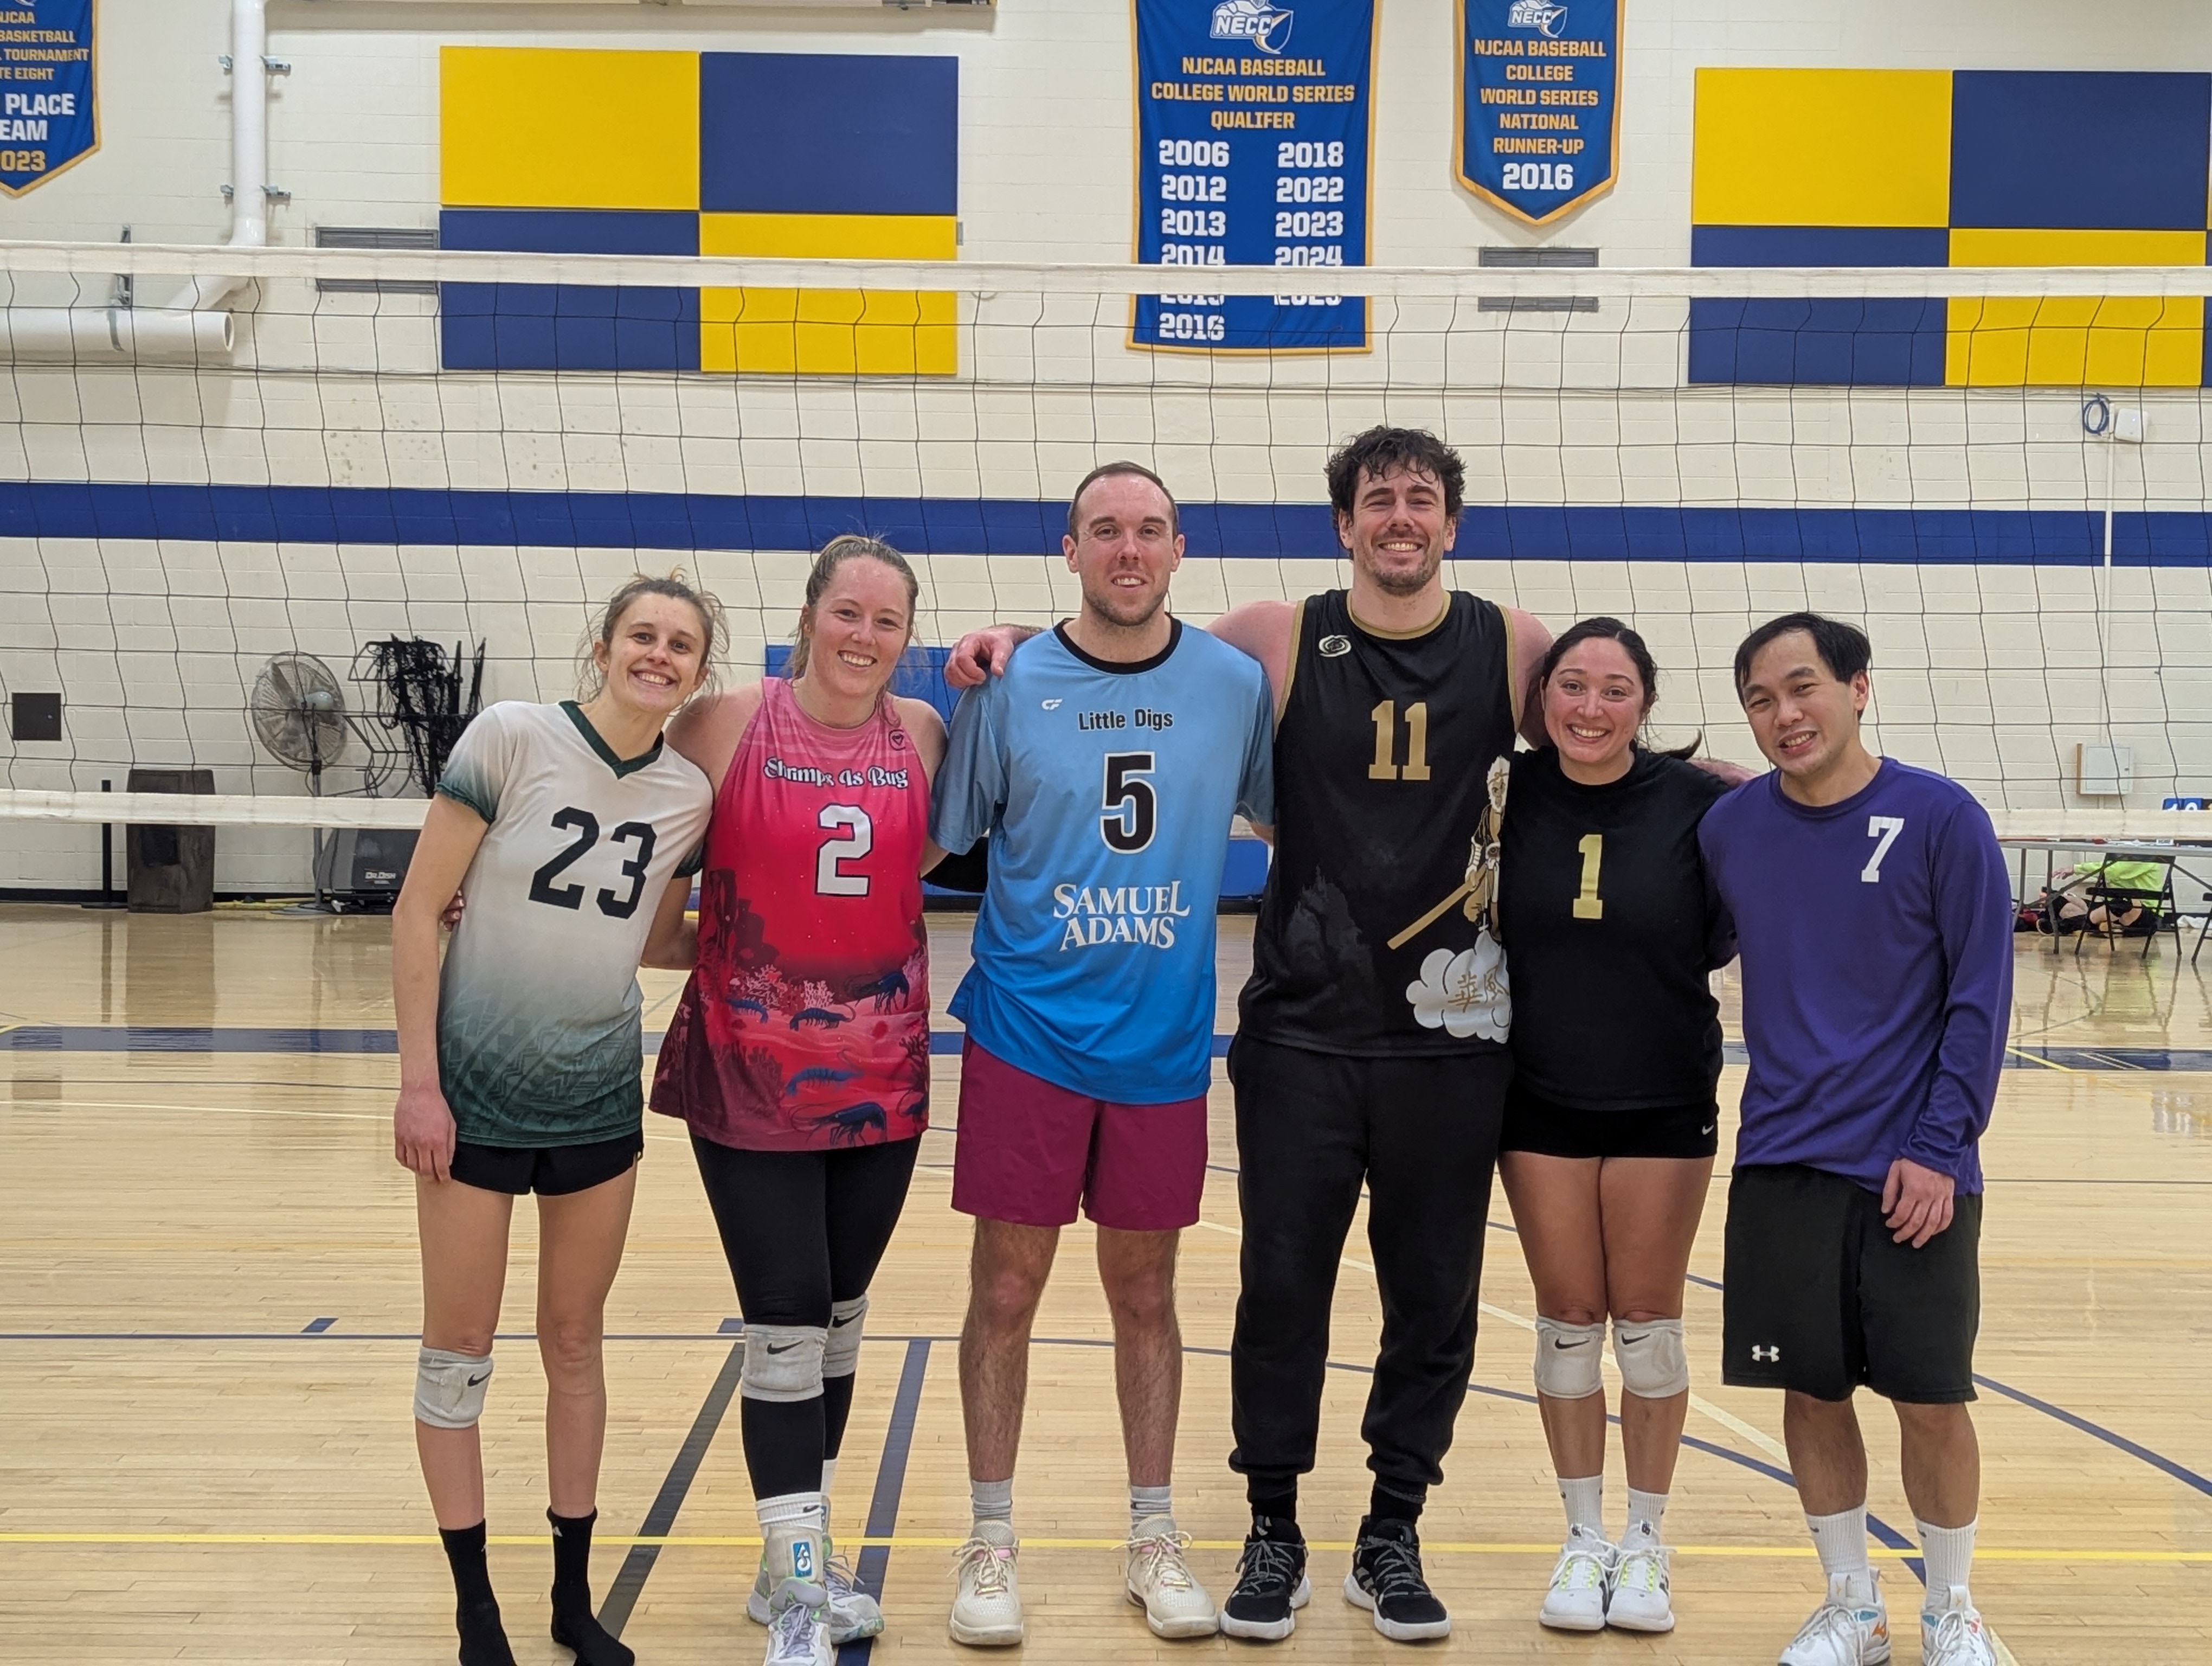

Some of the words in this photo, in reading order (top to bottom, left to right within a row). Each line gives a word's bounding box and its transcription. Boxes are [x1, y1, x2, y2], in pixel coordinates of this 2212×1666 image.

[1214, 16, 1272, 35] NECC
[1511, 11, 1553, 24] NECC
[3, 48, 89, 62] TOURNAMENT
[1475, 39, 1524, 56] NJCAA
[1528, 40, 1606, 57] BASEBALL
[14, 67, 55, 81] EIGHT
[1182, 57, 1237, 75] NJCAA
[1240, 59, 1326, 76] BASEBALL
[1506, 65, 1573, 81] COLLEGE
[1151, 82, 1224, 101] COLLEGE
[1227, 85, 1289, 102] WORLD
[1292, 85, 1355, 103] SERIES
[1481, 88, 1536, 105] WORLD
[1540, 90, 1598, 106] SERIES
[5, 93, 75, 116] PLACE
[1211, 111, 1295, 131] QUALIFER
[1500, 113, 1579, 130] NATIONAL
[1159, 139, 1230, 167] 2006
[1277, 141, 1344, 168] 2018
[1493, 138, 1584, 154] RUNNER-UP
[0, 150, 46, 171] 023
[1503, 163, 1573, 190] 2016
[1161, 175, 1227, 202] 2012
[1276, 176, 1344, 202] 2022
[1161, 208, 1226, 237] 2013
[1275, 211, 1343, 238] 2023
[1161, 243, 1225, 265] 2014
[1275, 245, 1343, 266] 2024
[1159, 312, 1225, 341] 2016
[1078, 712, 1126, 731] Little
[1134, 708, 1173, 731] Digs
[1368, 700, 1430, 780] 11
[764, 757, 834, 787] Shrimps
[868, 766, 908, 789] Bug
[1100, 752, 1156, 854] 5
[816, 804, 872, 896] 2
[1861, 816, 1905, 882] 7
[528, 806, 657, 919] 23
[1573, 834, 1603, 919] 1
[1053, 880, 1191, 918] SAMUEL
[1059, 917, 1175, 952] ADAMS
